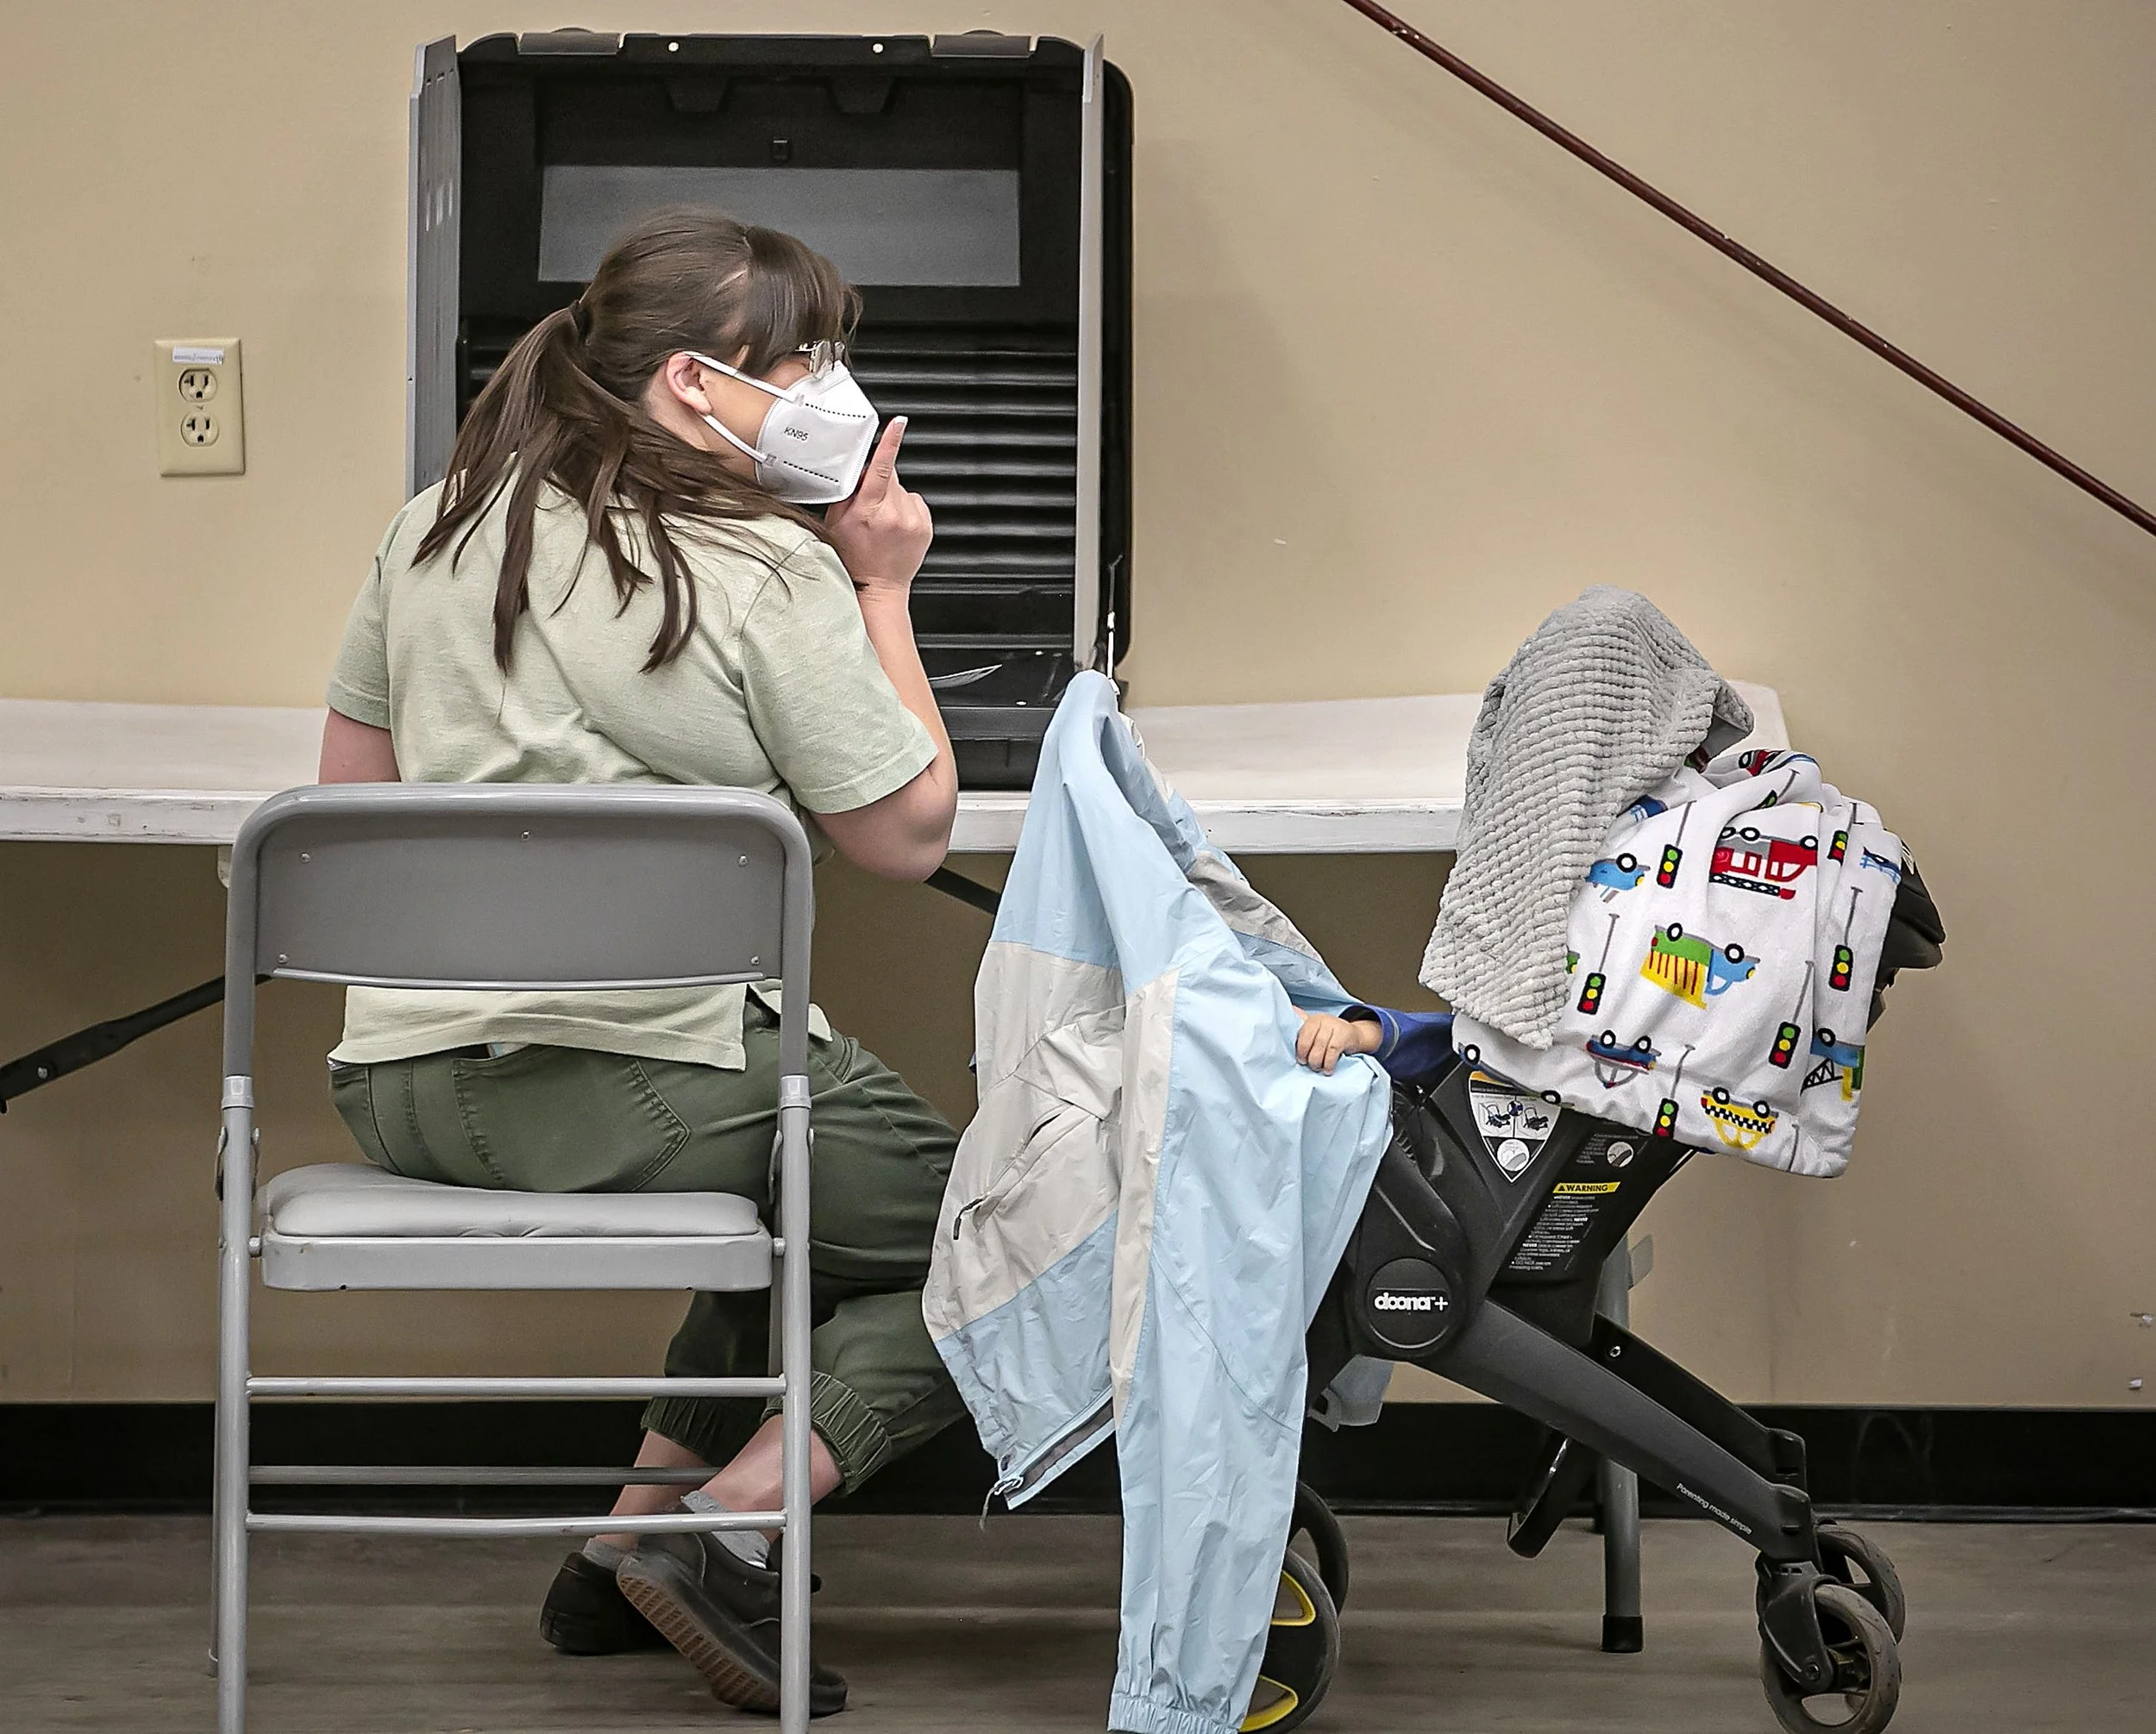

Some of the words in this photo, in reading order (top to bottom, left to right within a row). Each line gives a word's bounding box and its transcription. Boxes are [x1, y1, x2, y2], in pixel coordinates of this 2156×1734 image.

[784, 426, 808, 441] KN95
[1565, 1184, 1608, 1193] WARNING
[1677, 1483, 1708, 1508] Parenting
[1709, 1505, 1730, 1520] made
[1731, 1518, 1752, 1534] simple
